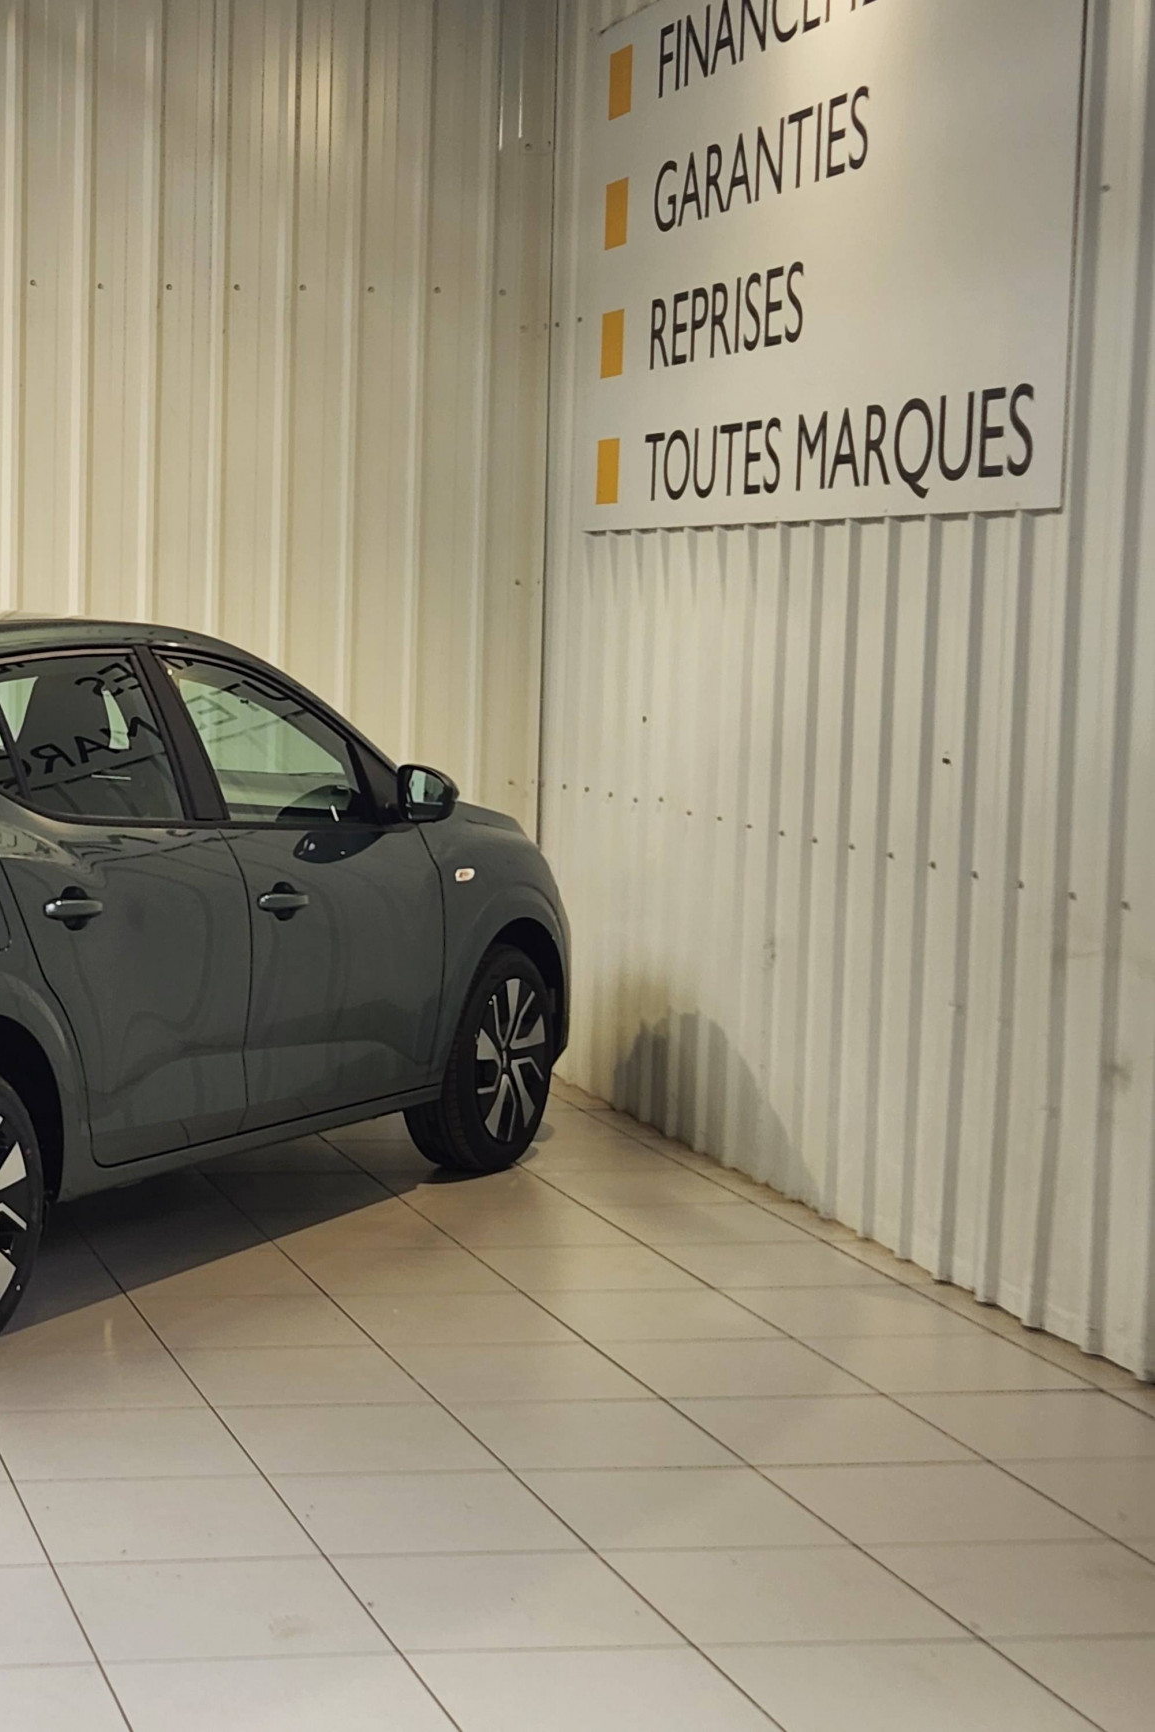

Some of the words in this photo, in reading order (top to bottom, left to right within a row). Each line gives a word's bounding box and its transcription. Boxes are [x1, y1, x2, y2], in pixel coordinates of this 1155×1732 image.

[658, 0, 877, 98] FINANC
[654, 86, 870, 232] GARANTIES
[649, 261, 804, 370] REPRISES
[645, 417, 781, 501] TOUTES
[795, 383, 1035, 499] MARQUES
